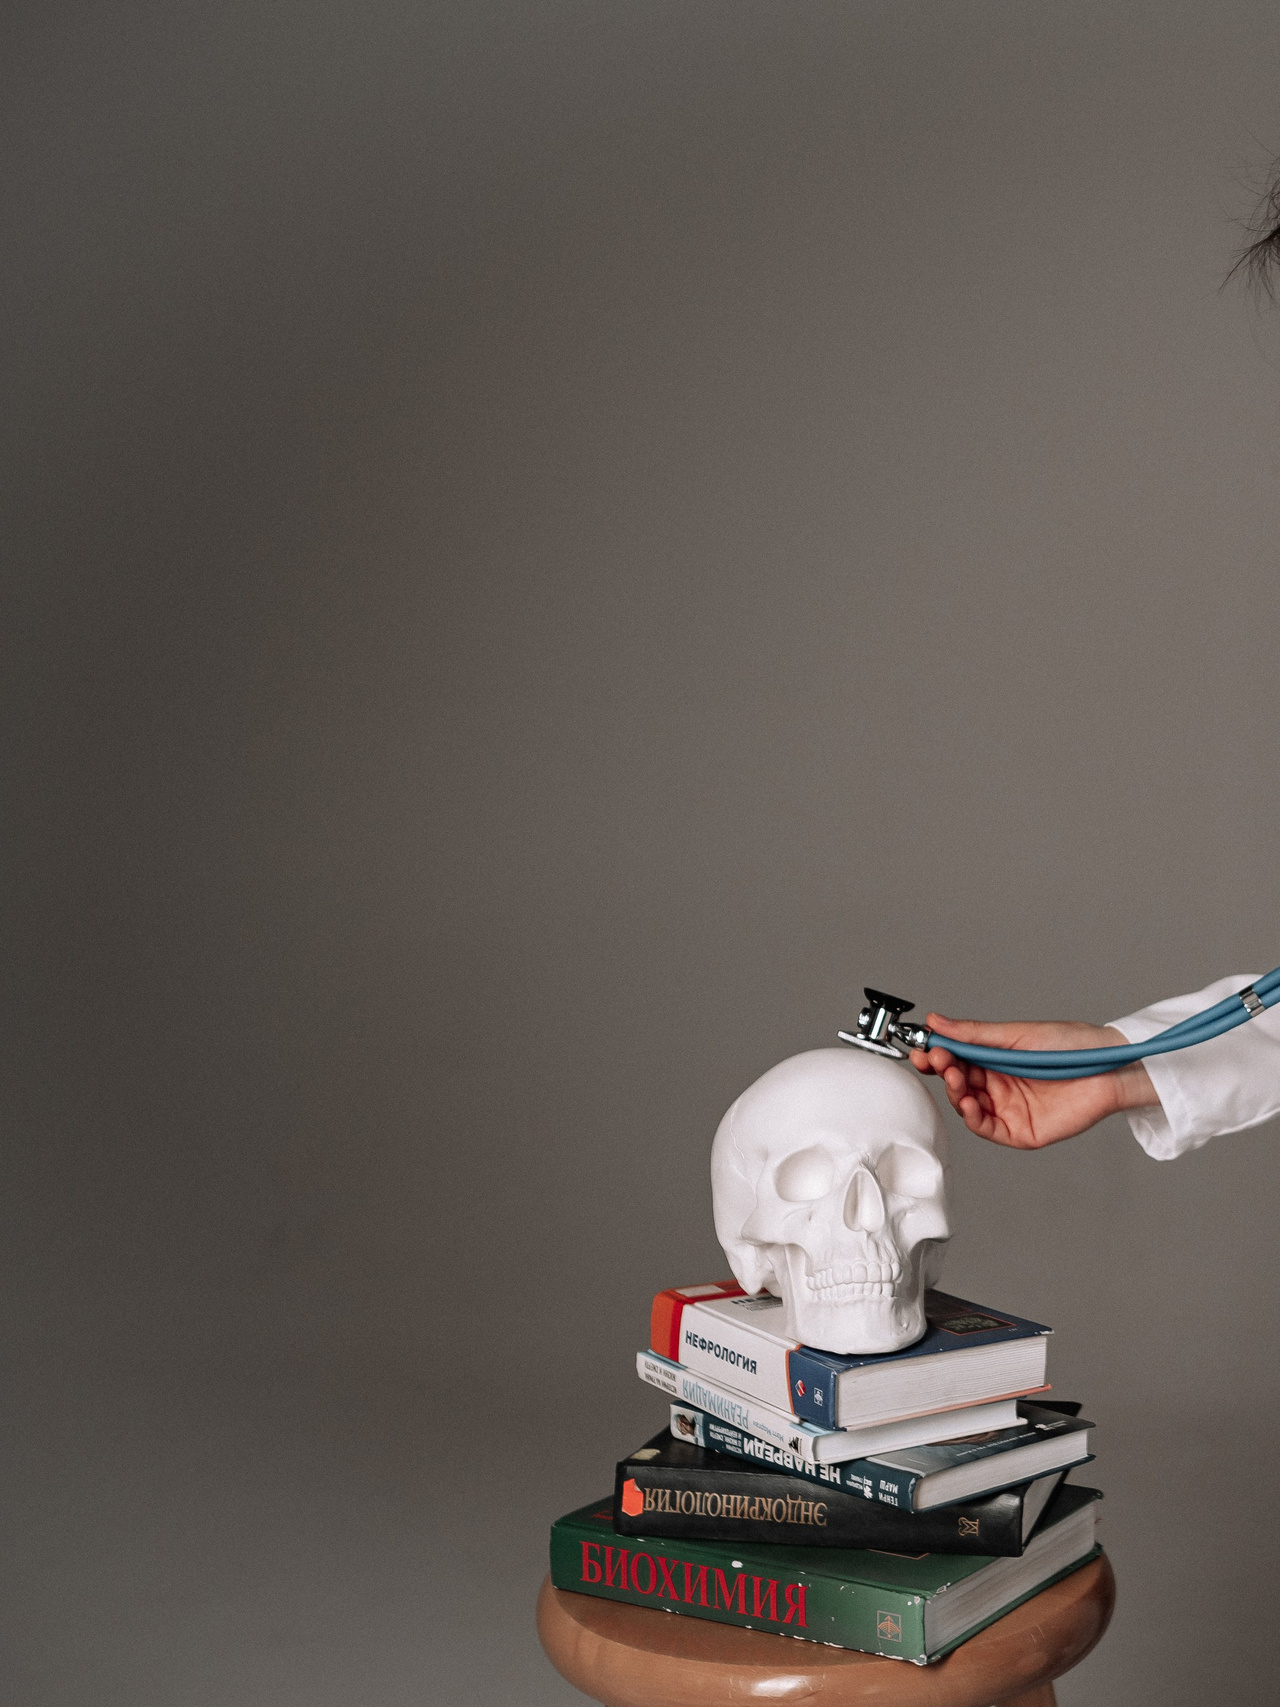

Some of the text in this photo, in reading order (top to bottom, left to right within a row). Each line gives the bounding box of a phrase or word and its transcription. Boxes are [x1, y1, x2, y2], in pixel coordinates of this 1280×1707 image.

[685, 1330, 758, 1375] НЕФРОЛОГИЯ
[682, 1378, 750, 1430] РЕАНИМАЦИЯ
[743, 1437, 817, 1477] НАВРЕДИ
[820, 1463, 841, 1485] НЕ
[643, 1487, 828, 1527] ЭНДОКРИНОЛОГИЯ
[879, 1479, 899, 1495] МАРШ
[579, 1540, 809, 1628] БИОХИМИЯ
